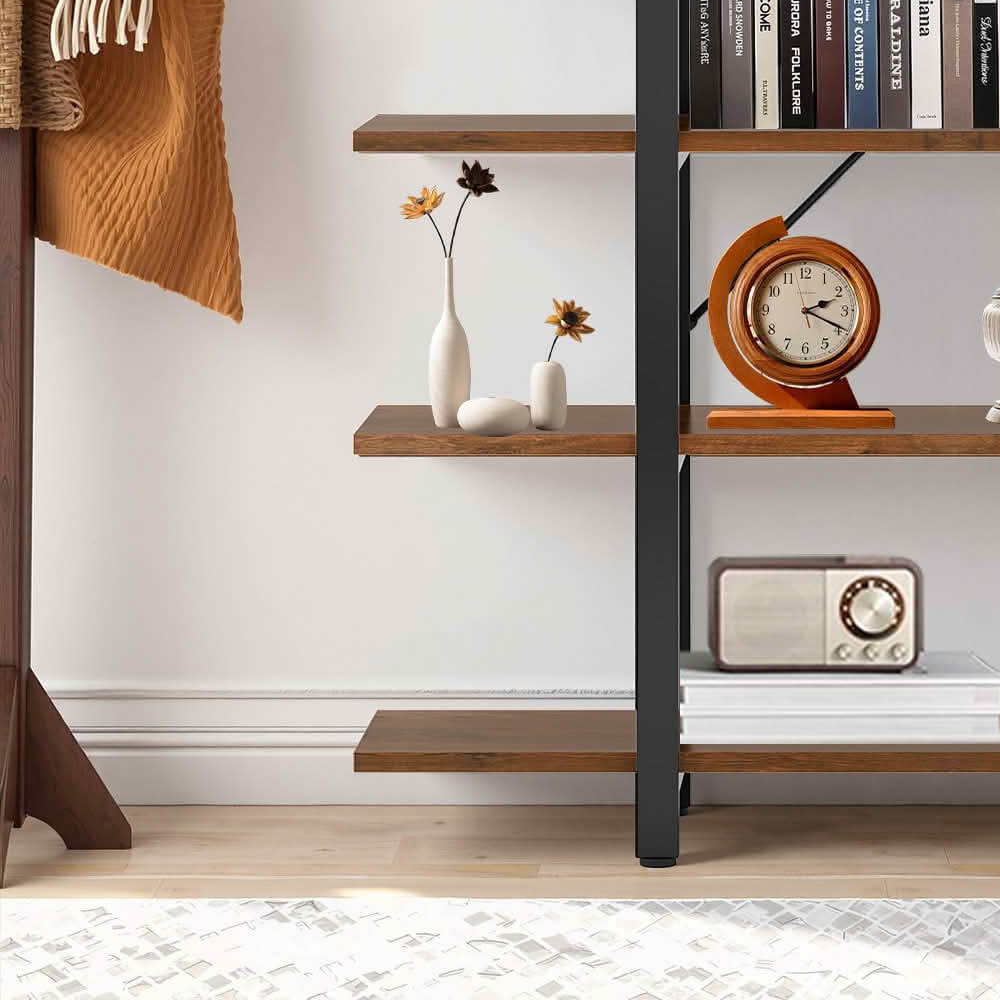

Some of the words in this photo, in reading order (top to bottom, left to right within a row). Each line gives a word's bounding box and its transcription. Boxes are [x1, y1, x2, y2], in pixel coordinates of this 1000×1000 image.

[853, 7, 863, 25] OF
[735, 14, 744, 57] SNOWDEN
[854, 27, 864, 91] CONTENTS
[791, 47, 801, 115] FOLKLORE
[783, 272, 794, 284] 11
[799, 267, 812, 279] 12
[822, 272, 827, 284] 1
[769, 286, 780, 297] 10
[835, 286, 843, 297] 2
[762, 304, 770, 316] 9
[840, 305, 849, 317] 3
[767, 323, 776, 335] 8
[784, 338, 792, 350] 7
[801, 342, 809, 354] 6
[820, 338, 829, 350] 5
